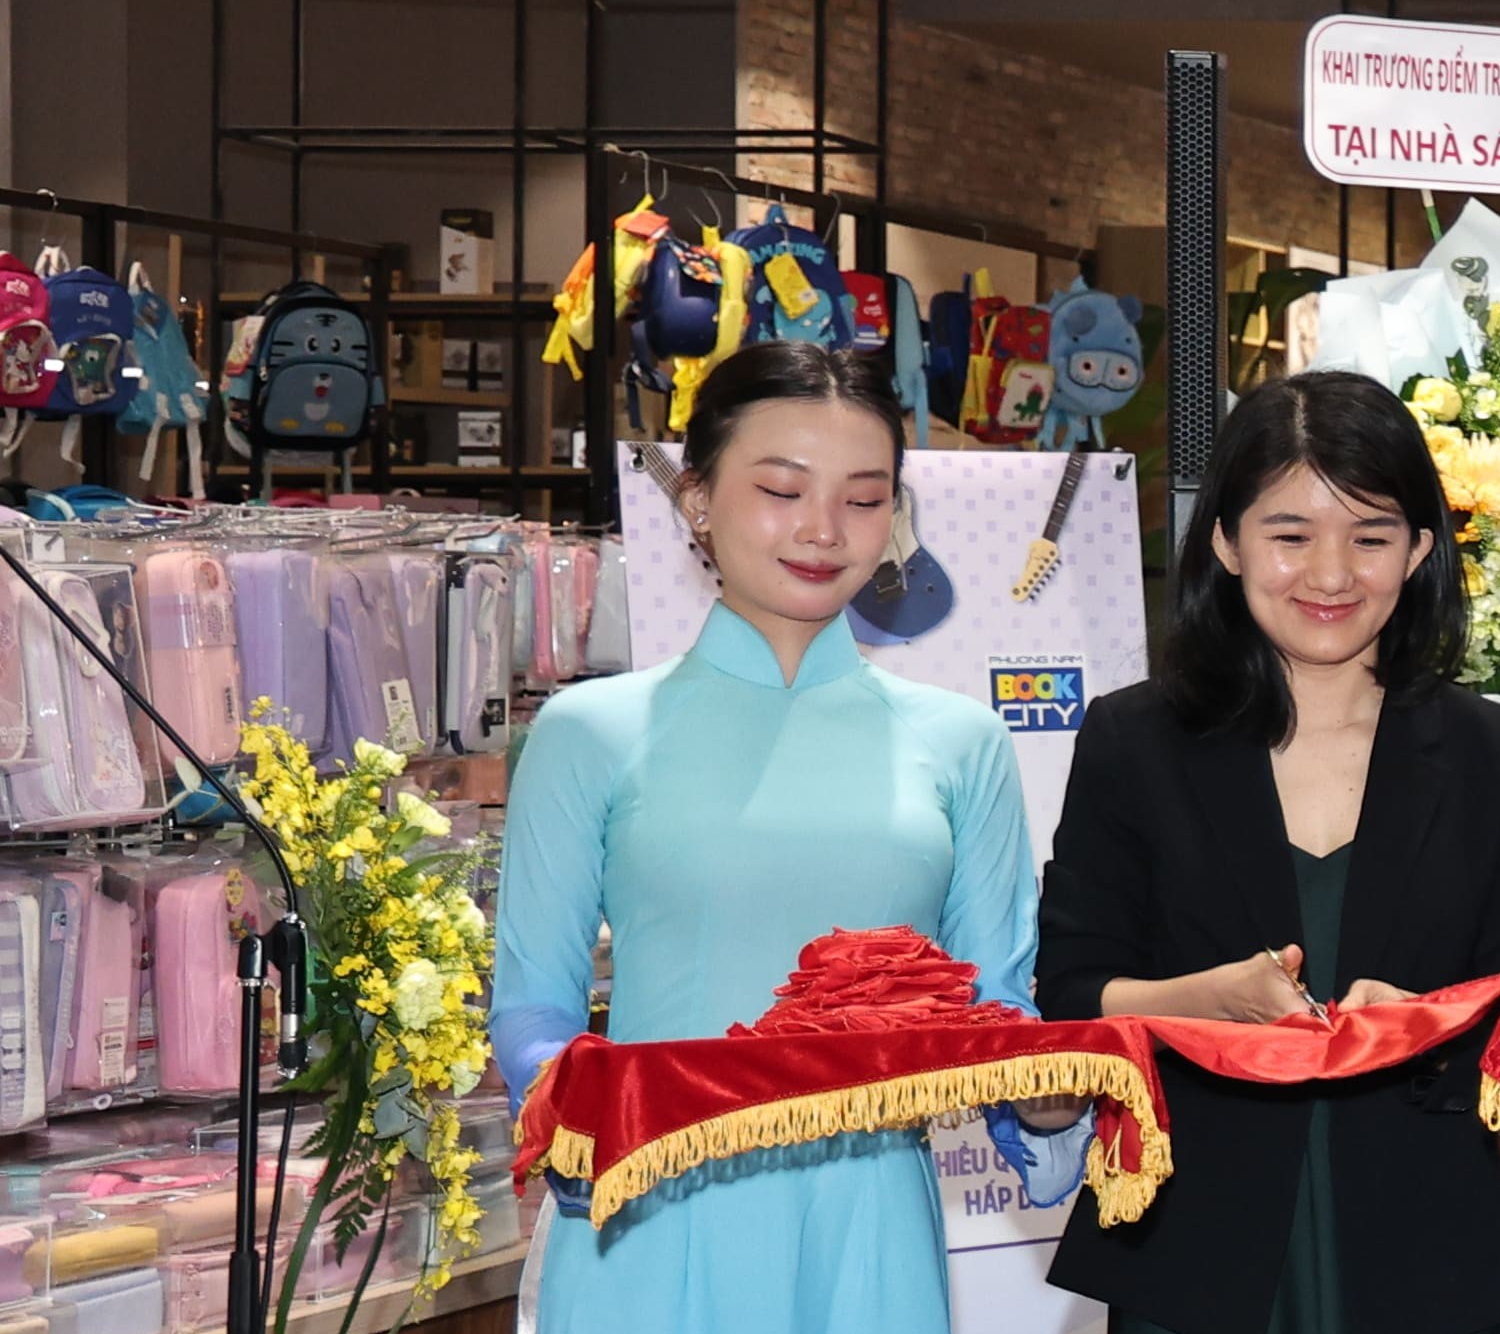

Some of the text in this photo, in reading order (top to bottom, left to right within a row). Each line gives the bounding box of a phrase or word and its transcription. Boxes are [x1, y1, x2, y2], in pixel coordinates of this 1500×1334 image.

[1322, 50, 1360, 84] KHAI
[1364, 52, 1434, 91] TRƯƠNG
[1438, 45, 1478, 94] ĐIỂM
[1328, 123, 1377, 166] TẠI
[1389, 123, 1462, 165] NHÀ
[1052, 655, 1083, 664] NAM
[996, 673, 1078, 702] BOOK
[998, 702, 1079, 727] CITY
[934, 1141, 987, 1178] HIỀU
[965, 1179, 1012, 1216] HẤP
